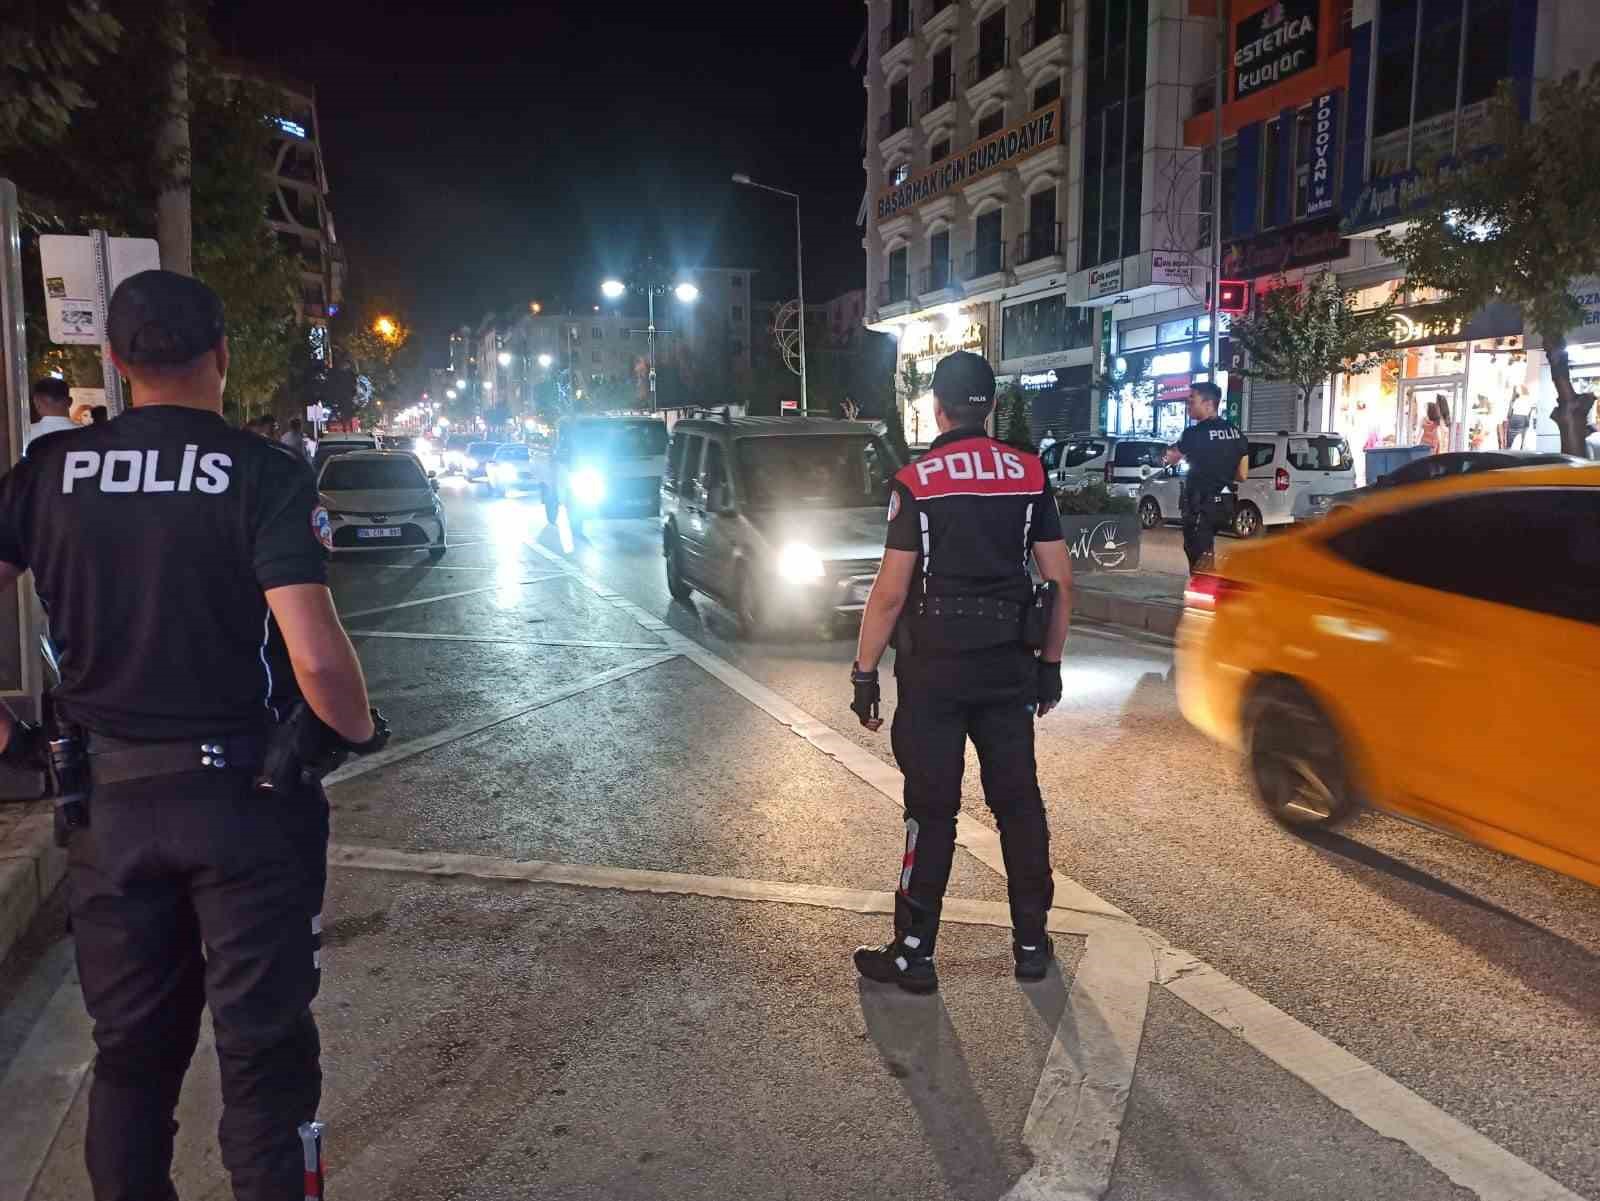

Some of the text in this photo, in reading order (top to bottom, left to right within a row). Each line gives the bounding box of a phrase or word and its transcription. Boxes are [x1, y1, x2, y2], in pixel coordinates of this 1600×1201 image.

[968, 110, 1057, 177] BURADAYIZ
[1314, 96, 1331, 182] PODOVAN
[62, 443, 233, 496] POLİS
[916, 447, 1025, 486] POLİS
